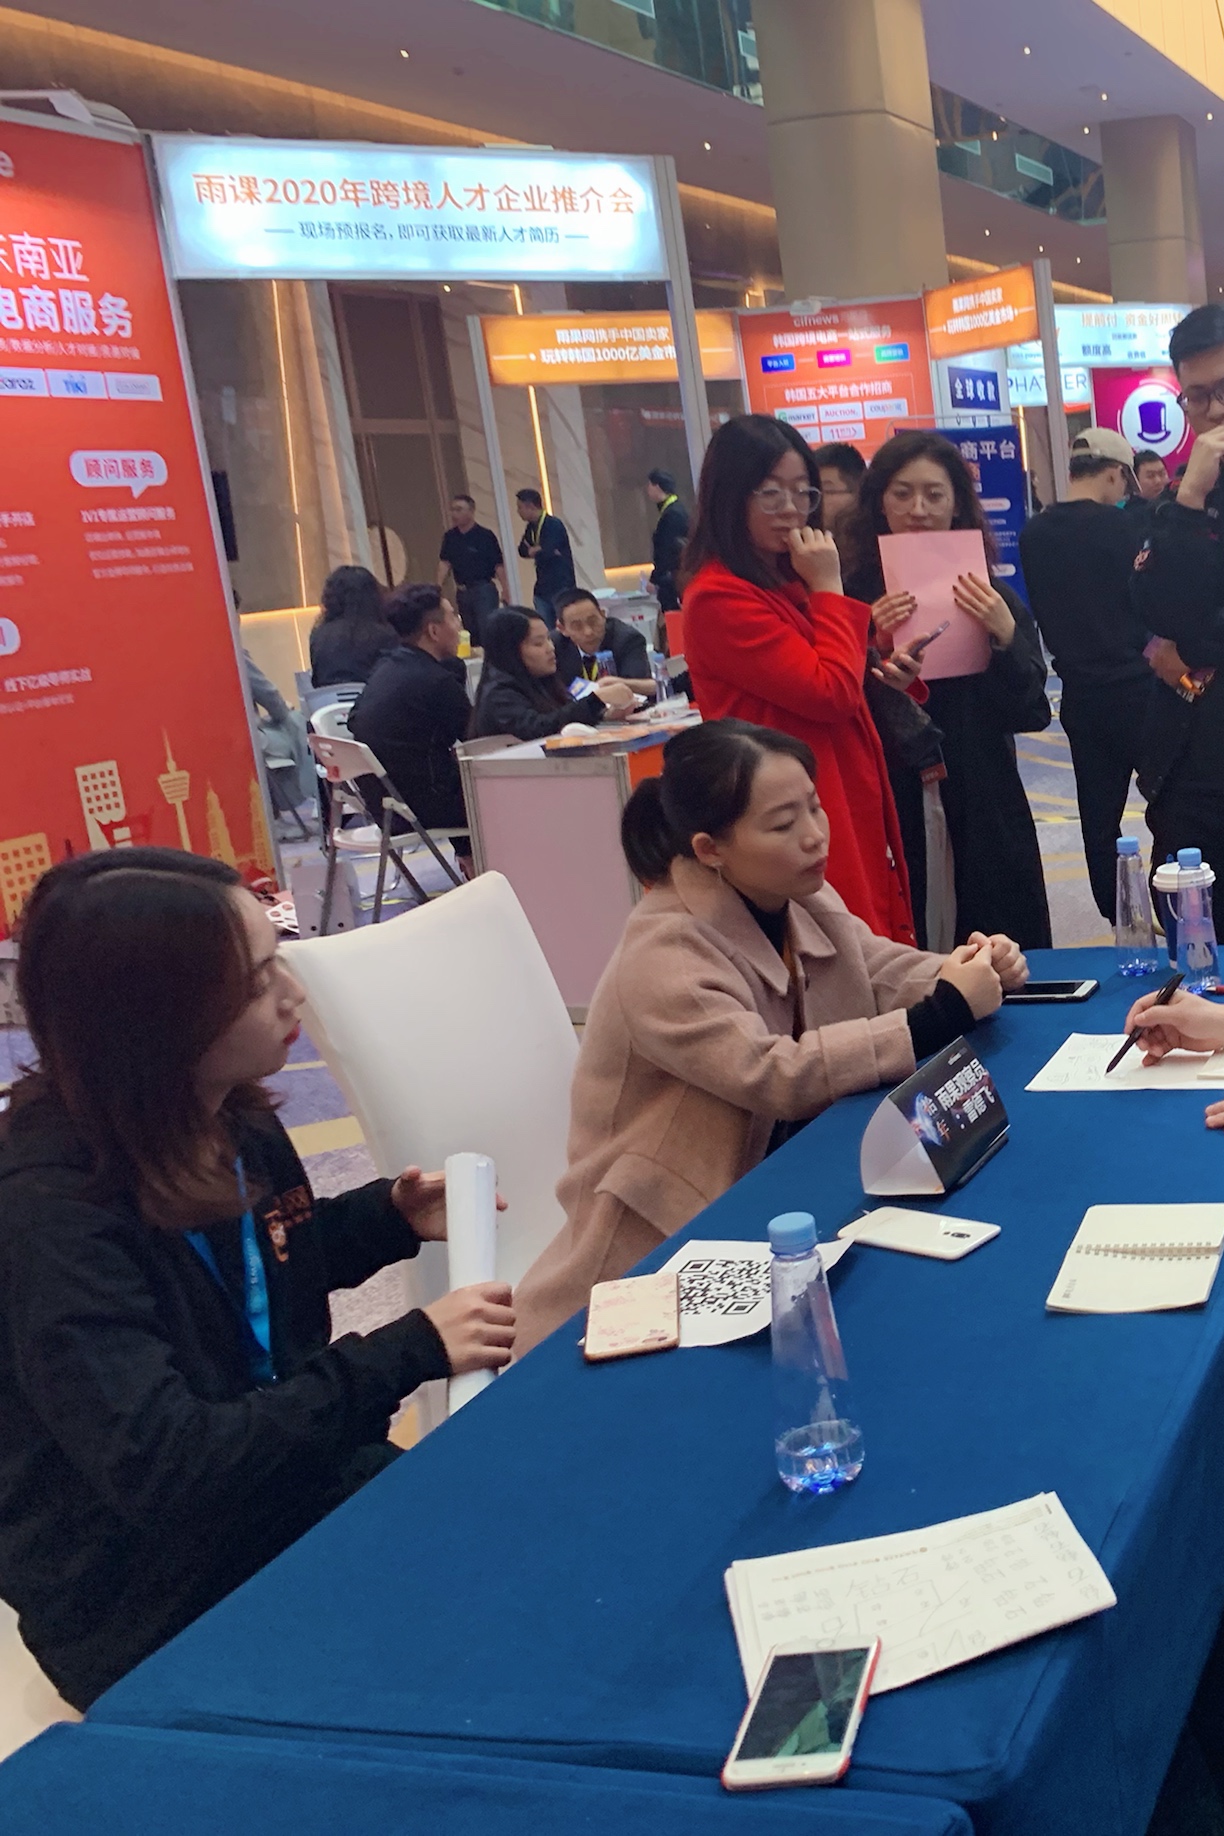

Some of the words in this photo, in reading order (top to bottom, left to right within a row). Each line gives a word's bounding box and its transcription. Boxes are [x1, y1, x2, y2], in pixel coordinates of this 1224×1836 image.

[192, 172, 636, 215] 雨课2020年跨境人才企业推介会
[785, 380, 893, 404] 韩国五大平台合作招商
[954, 440, 1017, 462] 商平台
[84, 457, 156, 480] 顾问服务
